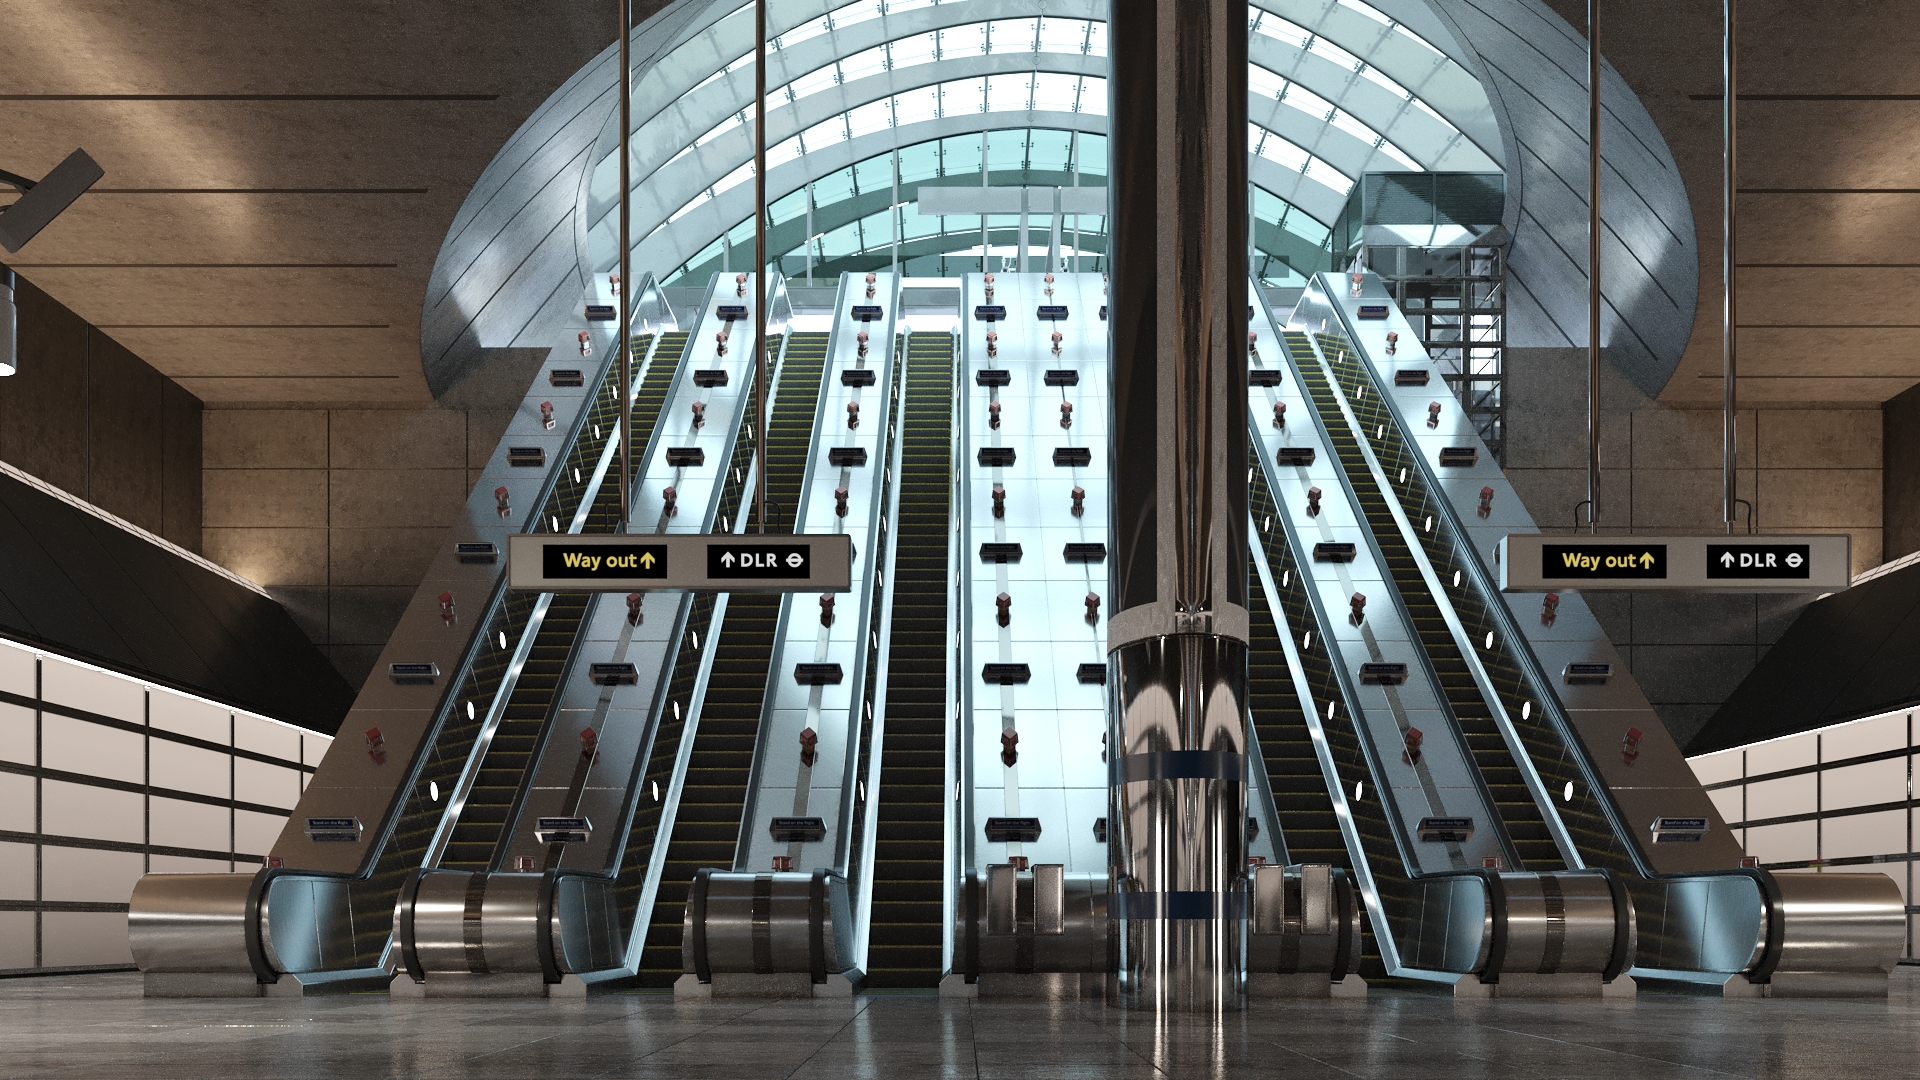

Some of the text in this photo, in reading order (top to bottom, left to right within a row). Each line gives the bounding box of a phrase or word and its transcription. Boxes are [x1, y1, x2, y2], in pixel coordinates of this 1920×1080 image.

[563, 552, 638, 572] Way out
[740, 552, 778, 568] DLR
[1562, 552, 1637, 572] Way out
[1739, 552, 1778, 568] DLR
